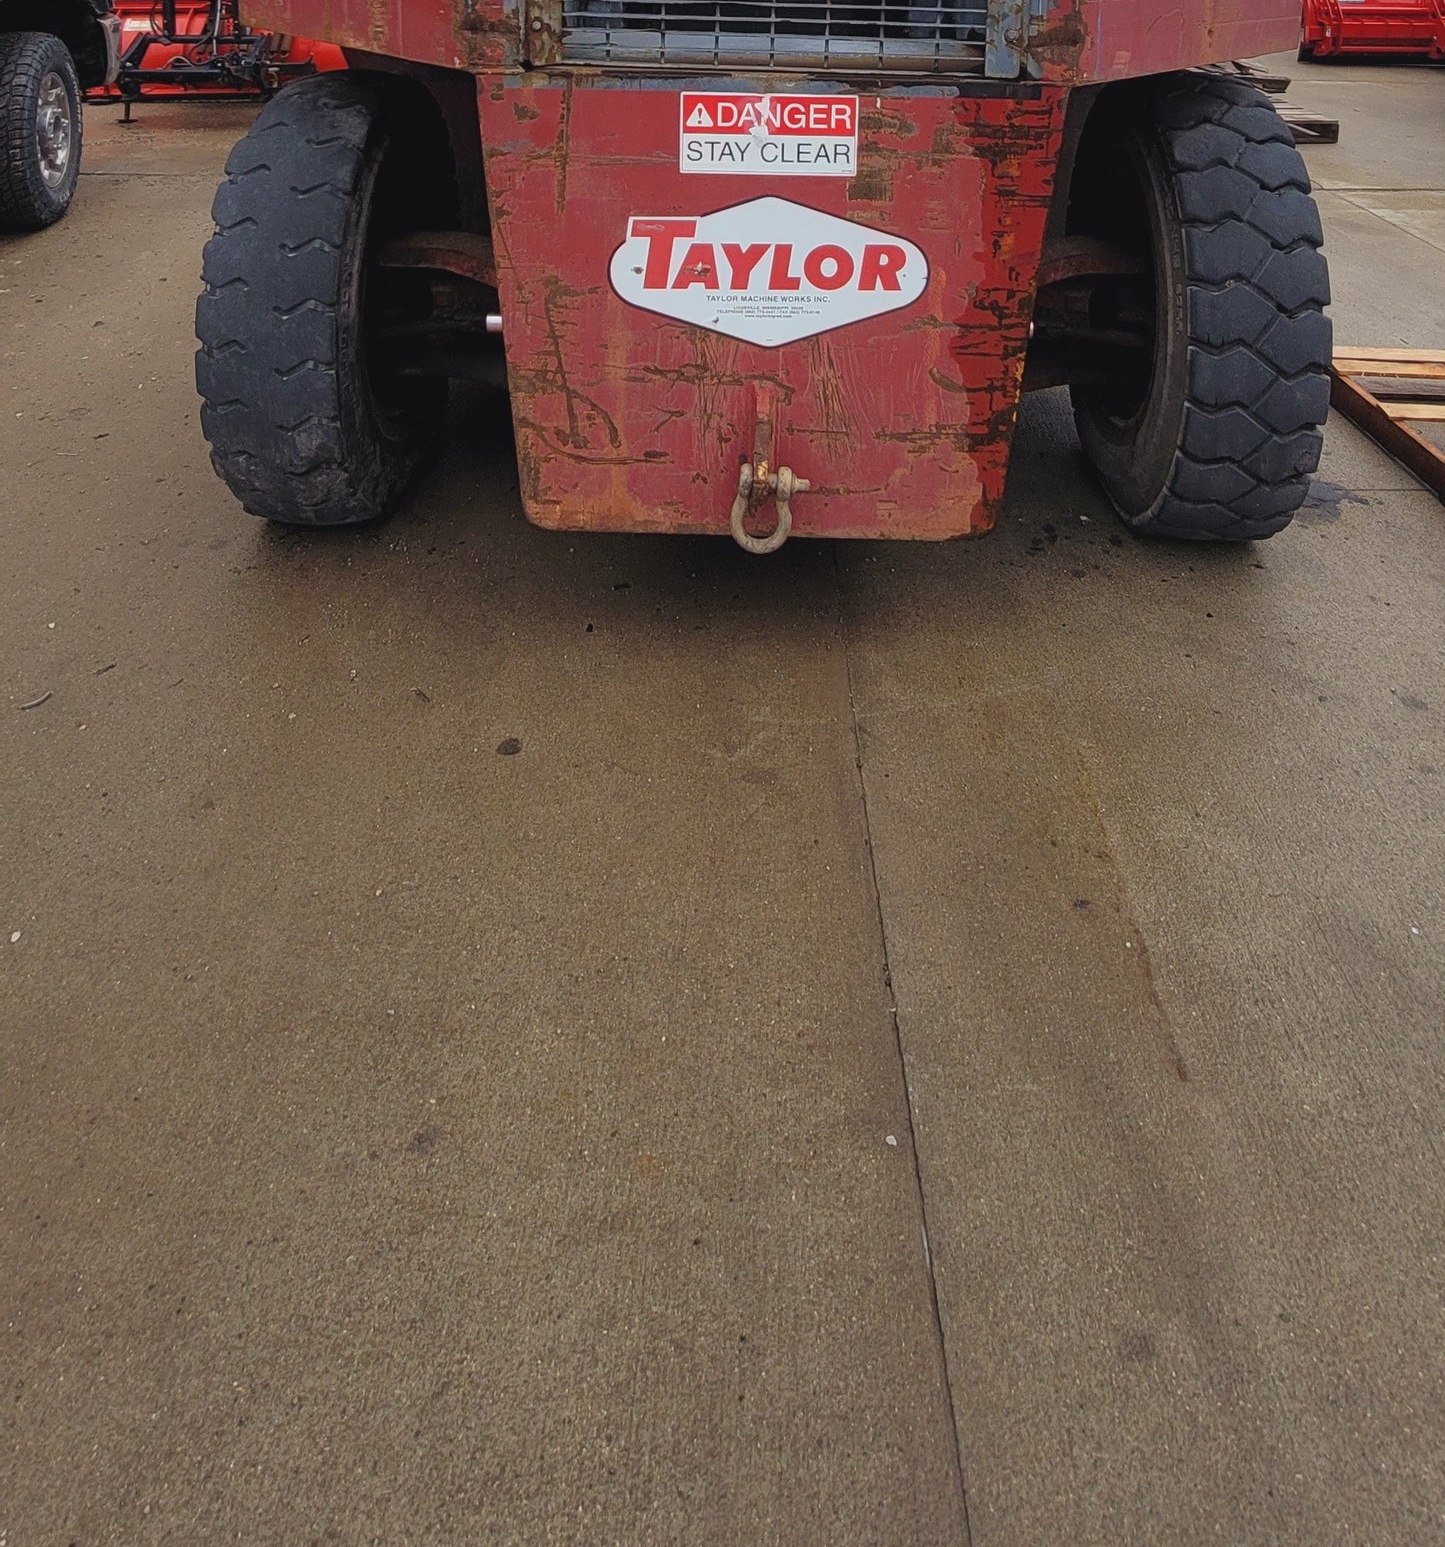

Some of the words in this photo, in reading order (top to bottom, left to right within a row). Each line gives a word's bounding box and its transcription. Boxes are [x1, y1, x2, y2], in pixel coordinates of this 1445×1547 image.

[717, 102, 852, 129] DANGER
[686, 140, 751, 162] STAY
[760, 142, 851, 164] CLEAR
[630, 218, 908, 291] TAYLOR
[740, 295, 779, 303] MACHINE
[780, 295, 812, 303] WORKS
